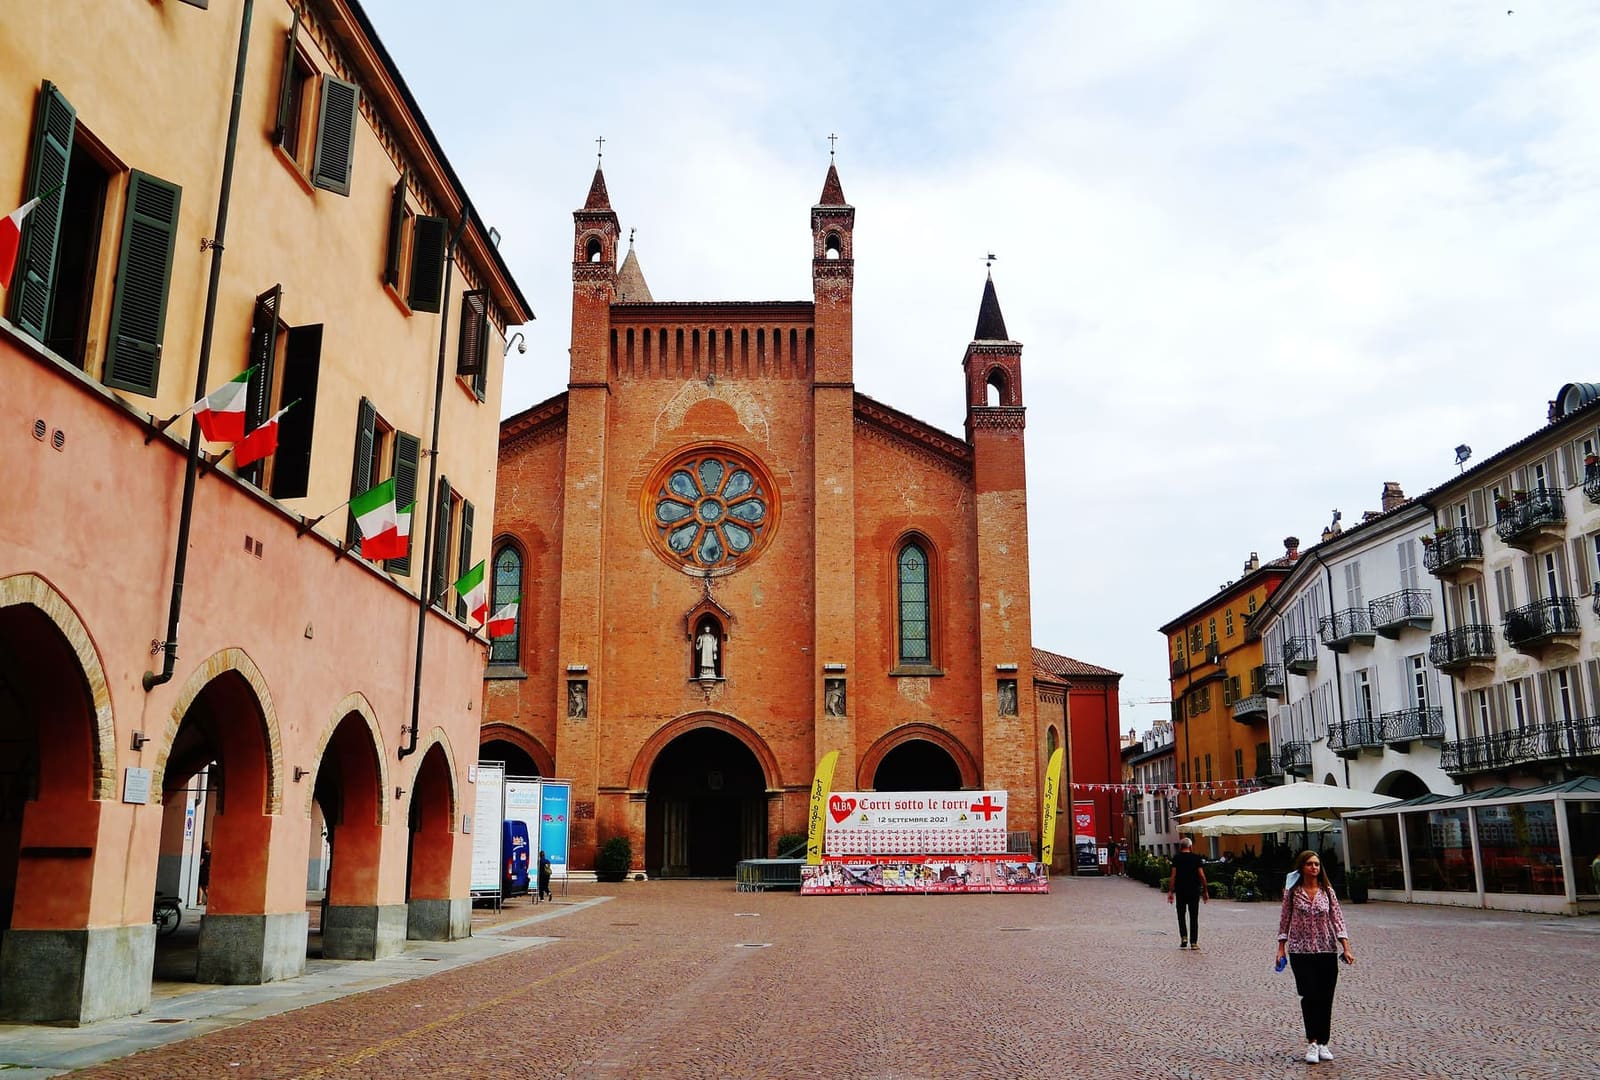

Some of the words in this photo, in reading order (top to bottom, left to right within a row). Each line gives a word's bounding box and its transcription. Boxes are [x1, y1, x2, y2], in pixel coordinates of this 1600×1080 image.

[813, 779, 823, 801] Sport
[832, 801, 852, 811] ALBA
[859, 798, 891, 810] Corri
[894, 799, 924, 810] sotto
[928, 798, 938, 810] le
[942, 800, 968, 810] torri
